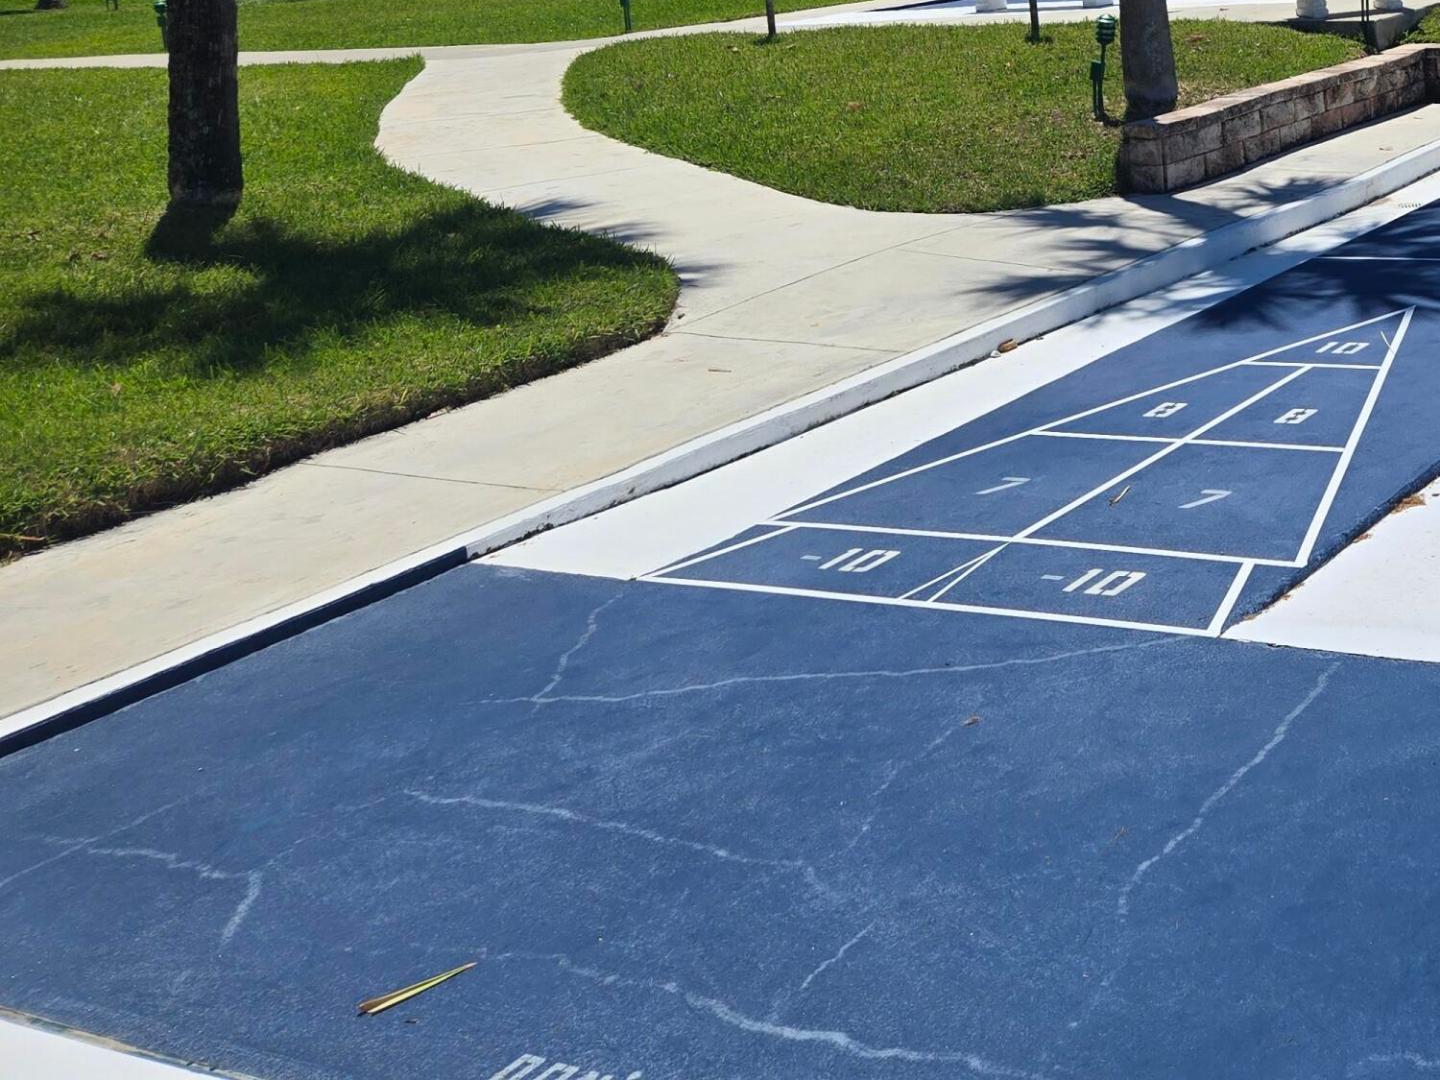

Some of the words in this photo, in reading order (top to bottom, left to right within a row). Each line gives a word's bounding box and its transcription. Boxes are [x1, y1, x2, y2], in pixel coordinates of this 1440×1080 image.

[1316, 340, 1370, 355] 10
[1142, 401, 1188, 418] 8
[1273, 407, 1319, 424] 8
[976, 476, 1031, 495] 7
[1178, 489, 1232, 509] 7
[801, 548, 901, 573] -10
[1041, 568, 1147, 597] -10
